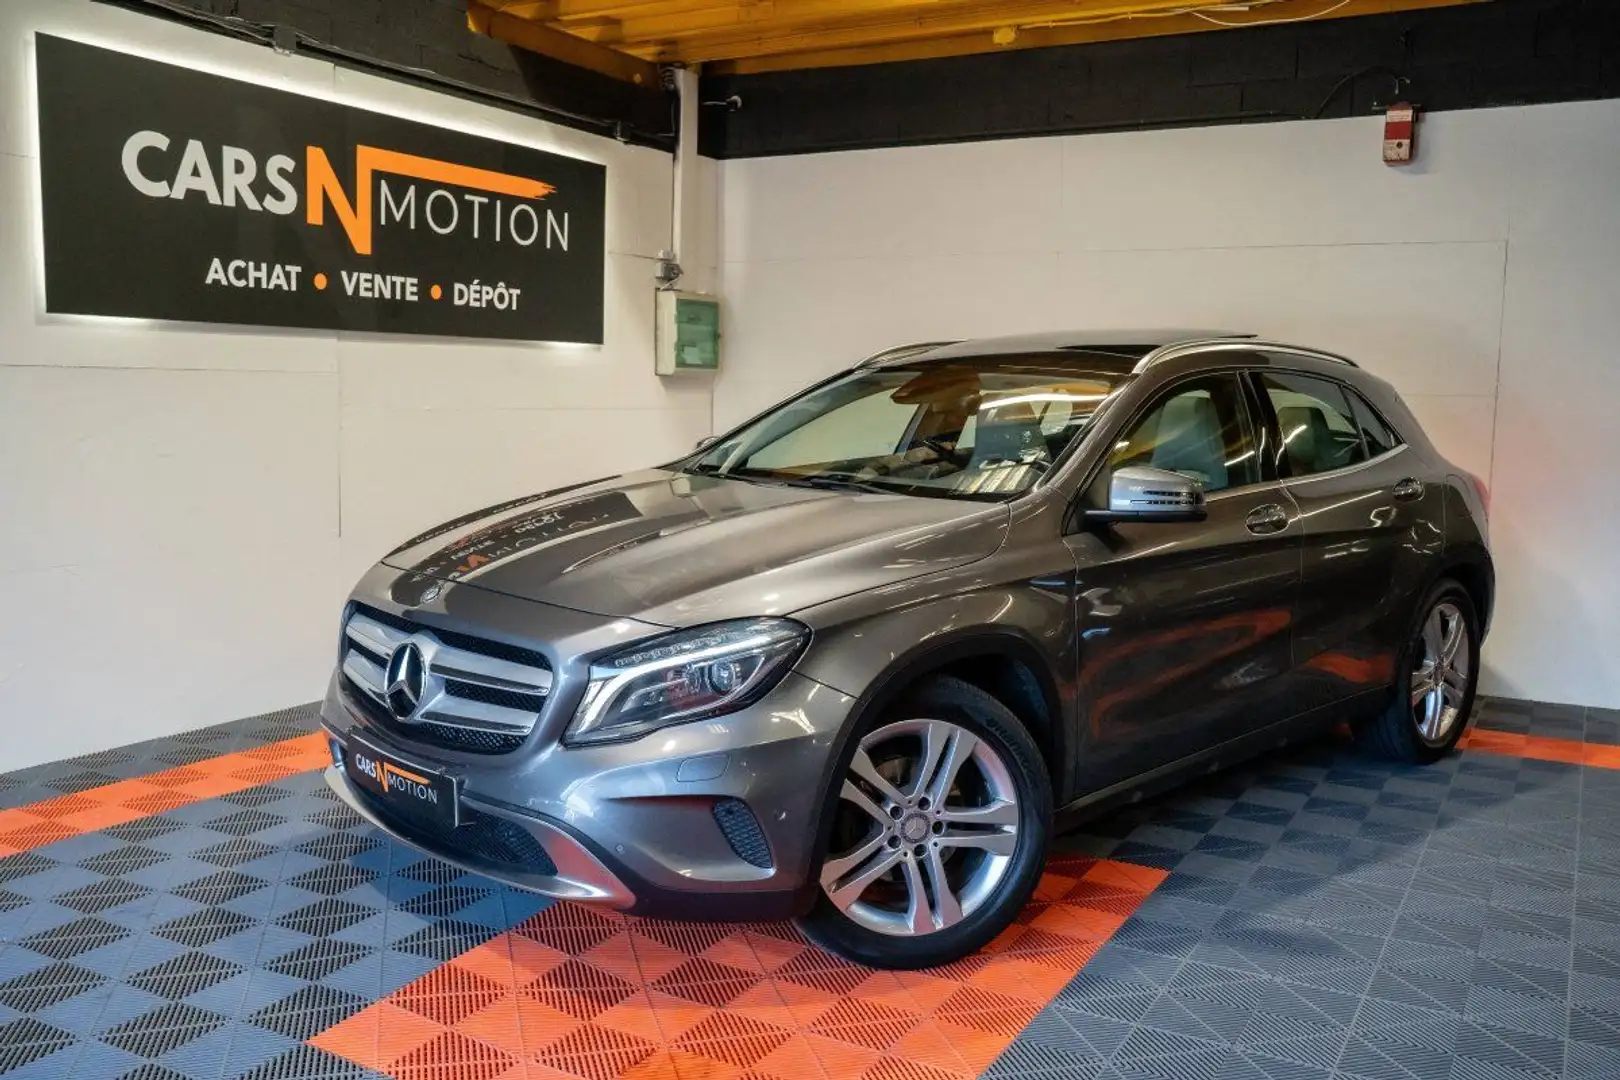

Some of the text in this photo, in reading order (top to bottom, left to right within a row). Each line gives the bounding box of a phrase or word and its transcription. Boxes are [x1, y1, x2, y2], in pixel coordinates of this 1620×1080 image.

[121, 129, 299, 216] CARS
[204, 257, 521, 311] ACHAT VENTE DÉPÔT
